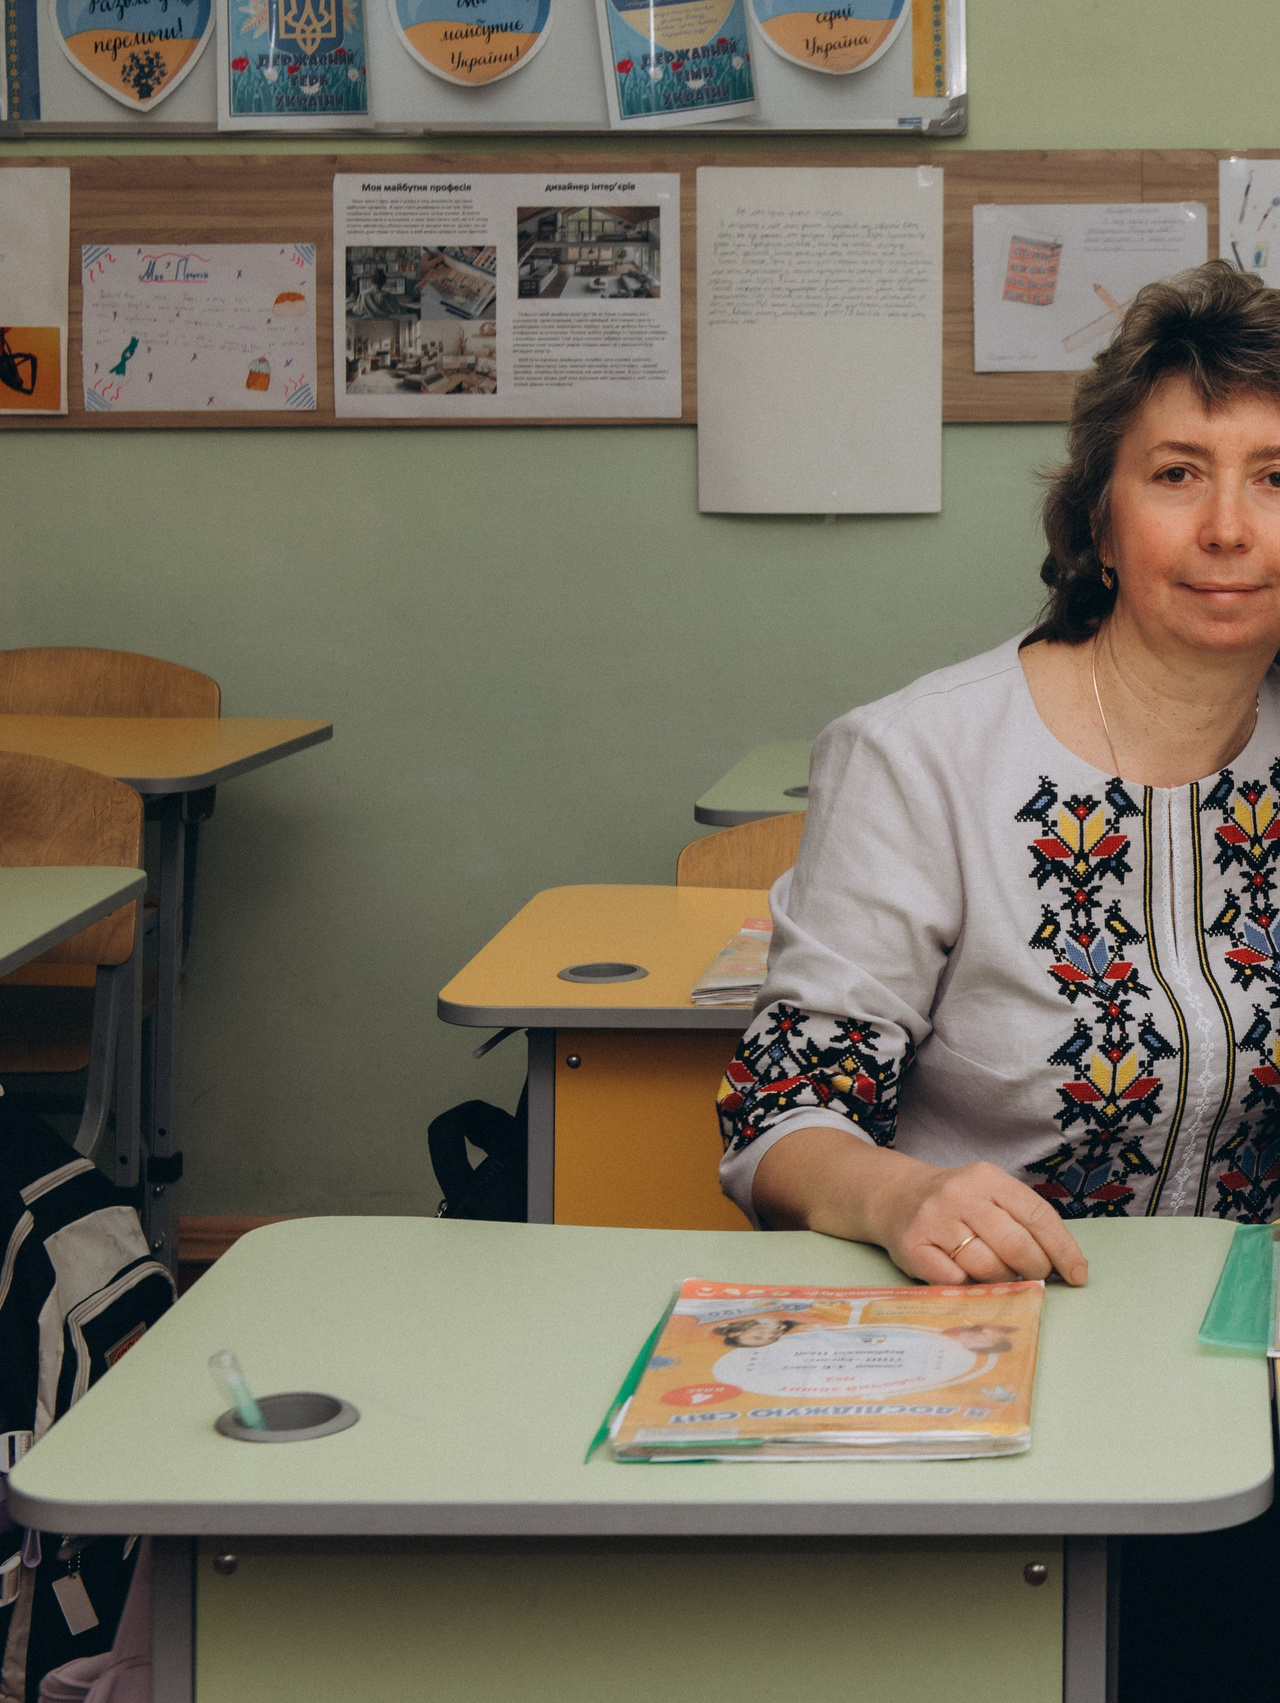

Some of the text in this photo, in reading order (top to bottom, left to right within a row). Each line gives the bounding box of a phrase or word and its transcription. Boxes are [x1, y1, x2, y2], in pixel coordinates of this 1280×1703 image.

[816, 4, 855, 30] серці
[94, 17, 183, 62] перемоги!
[803, 35, 871, 60] Україна
[256, 48, 354, 70] ДЕРЖАВНИЙ
[450, 45, 519, 73] України!
[641, 38, 738, 70] ДЕРЖАВНИЙ
[290, 74, 328, 87] ГЕРБ
[274, 92, 343, 108] УКРАЇНИ
[662, 83, 730, 106] УКРАЇНИ
[361, 181, 472, 193] Моя майбутня професія
[544, 181, 590, 193] дизайнер
[690, 1393, 714, 1405] 4
[669, 1411, 740, 1424] СВІТ
[749, 1404, 956, 1419] ДОСЛІДЖУЮ
